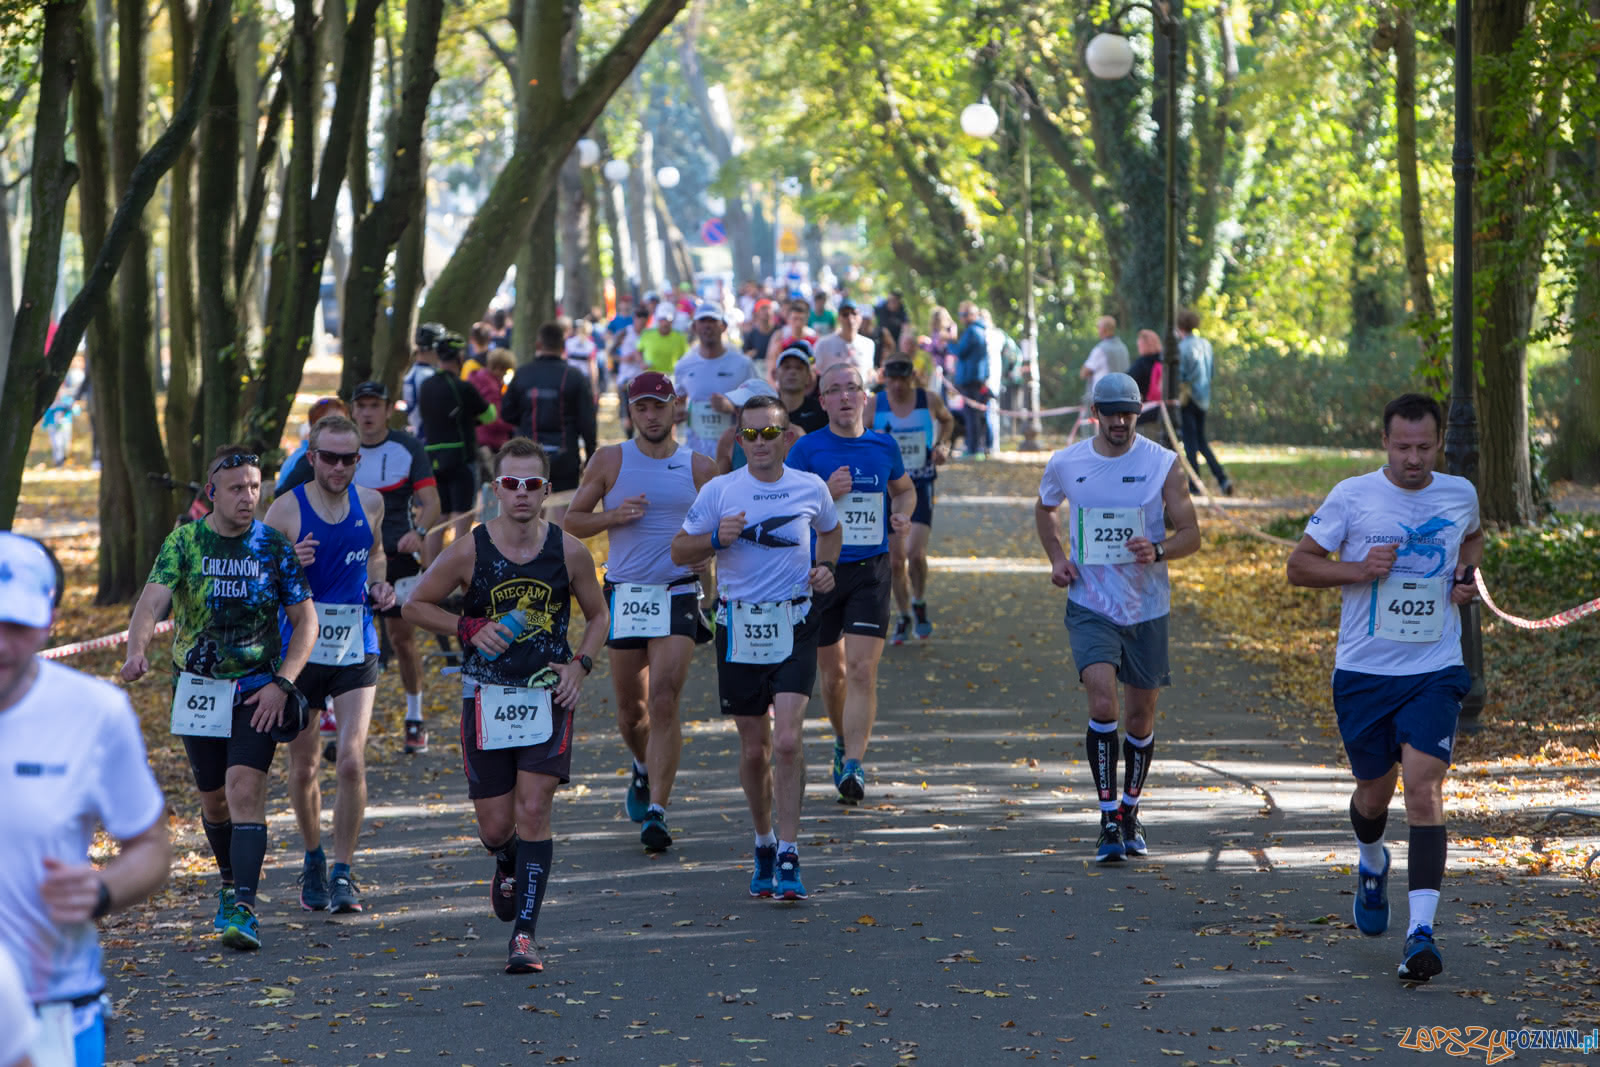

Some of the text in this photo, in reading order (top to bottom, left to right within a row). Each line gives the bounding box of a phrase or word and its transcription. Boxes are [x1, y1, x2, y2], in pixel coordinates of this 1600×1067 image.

[753, 493, 790, 502] GIVOVA
[845, 511, 876, 524] 3714
[1094, 527, 1134, 542] 2239
[202, 555, 260, 577] CHRZANÓW
[213, 577, 249, 598] BIEGA
[496, 585, 547, 602] BIEGAM
[622, 601, 660, 616] 2045
[1388, 599, 1436, 616] 4023
[744, 623, 779, 639] 3331
[187, 695, 216, 711] 621
[494, 704, 539, 721] 4897
[520, 862, 544, 920] Kalenji
